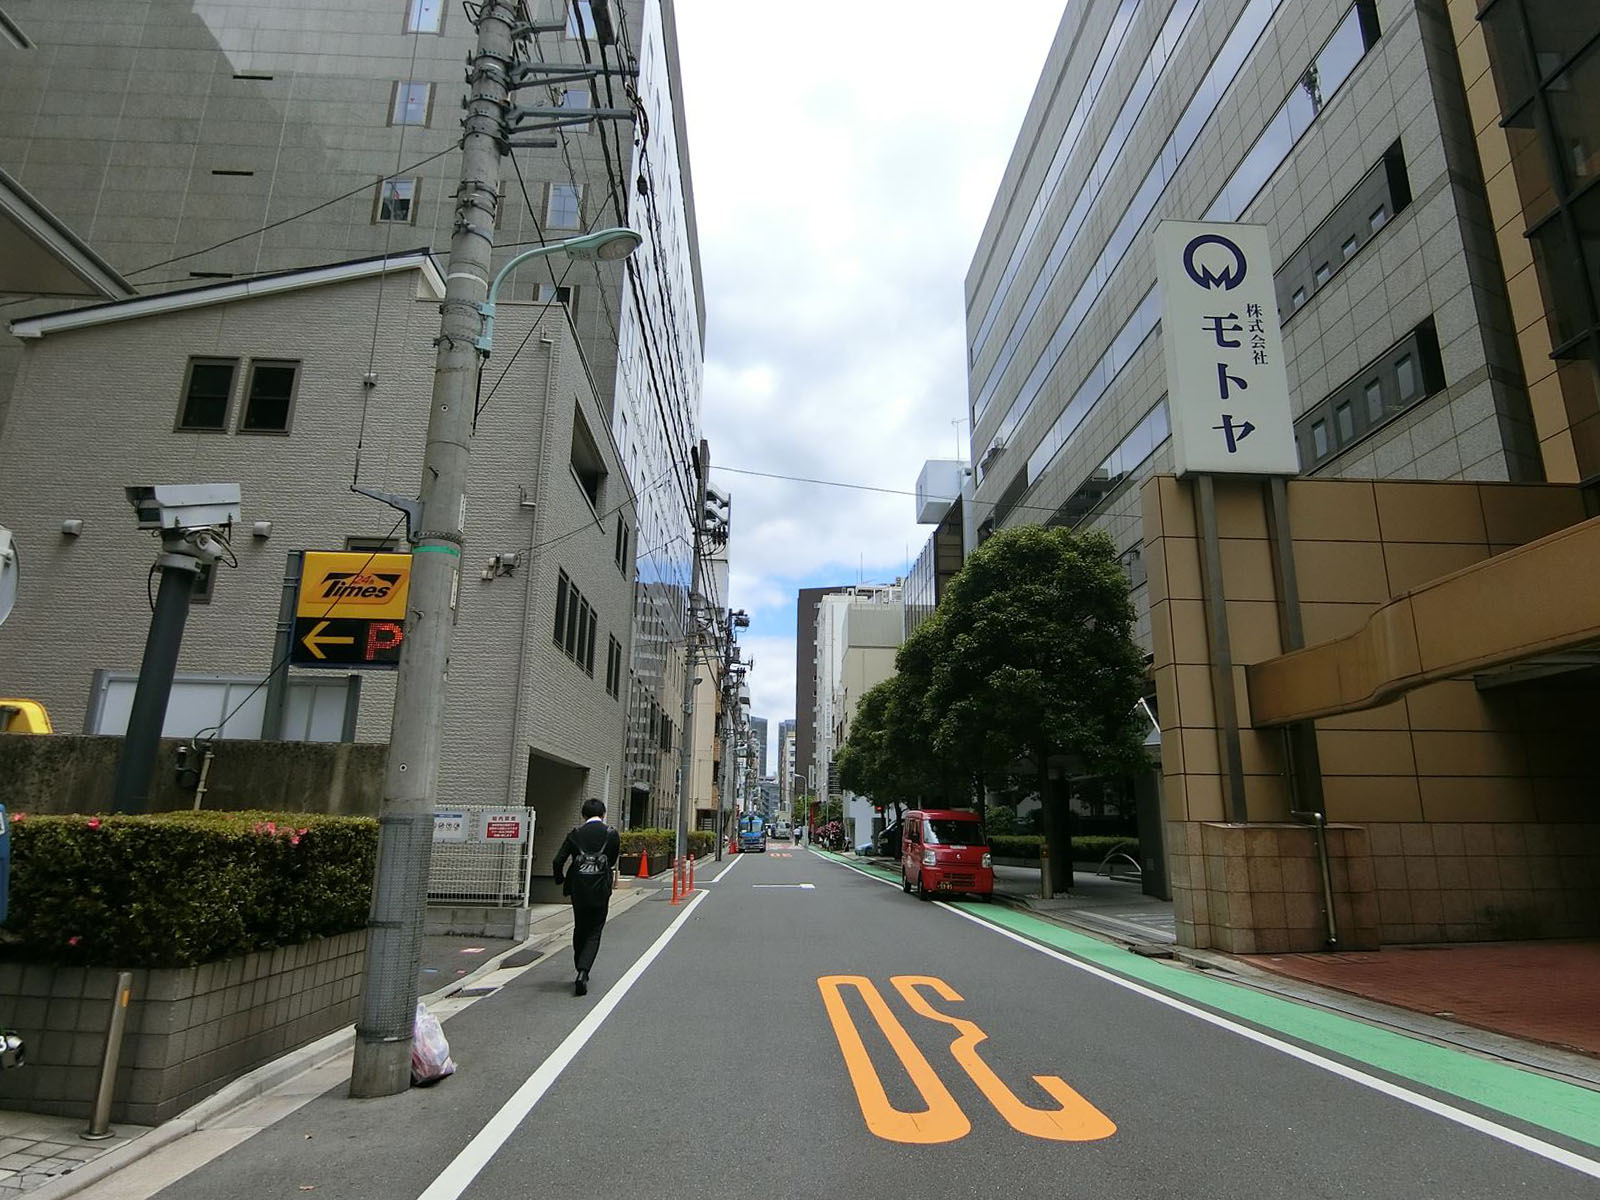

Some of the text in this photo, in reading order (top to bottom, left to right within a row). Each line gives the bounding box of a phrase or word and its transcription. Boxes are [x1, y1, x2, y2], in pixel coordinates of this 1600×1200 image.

[1246, 303, 1269, 366] 株式会社
[1201, 312, 1256, 454] モトヤ
[321, 573, 392, 599] Times
[366, 623, 404, 661] P
[817, 975, 1118, 1144] 30
